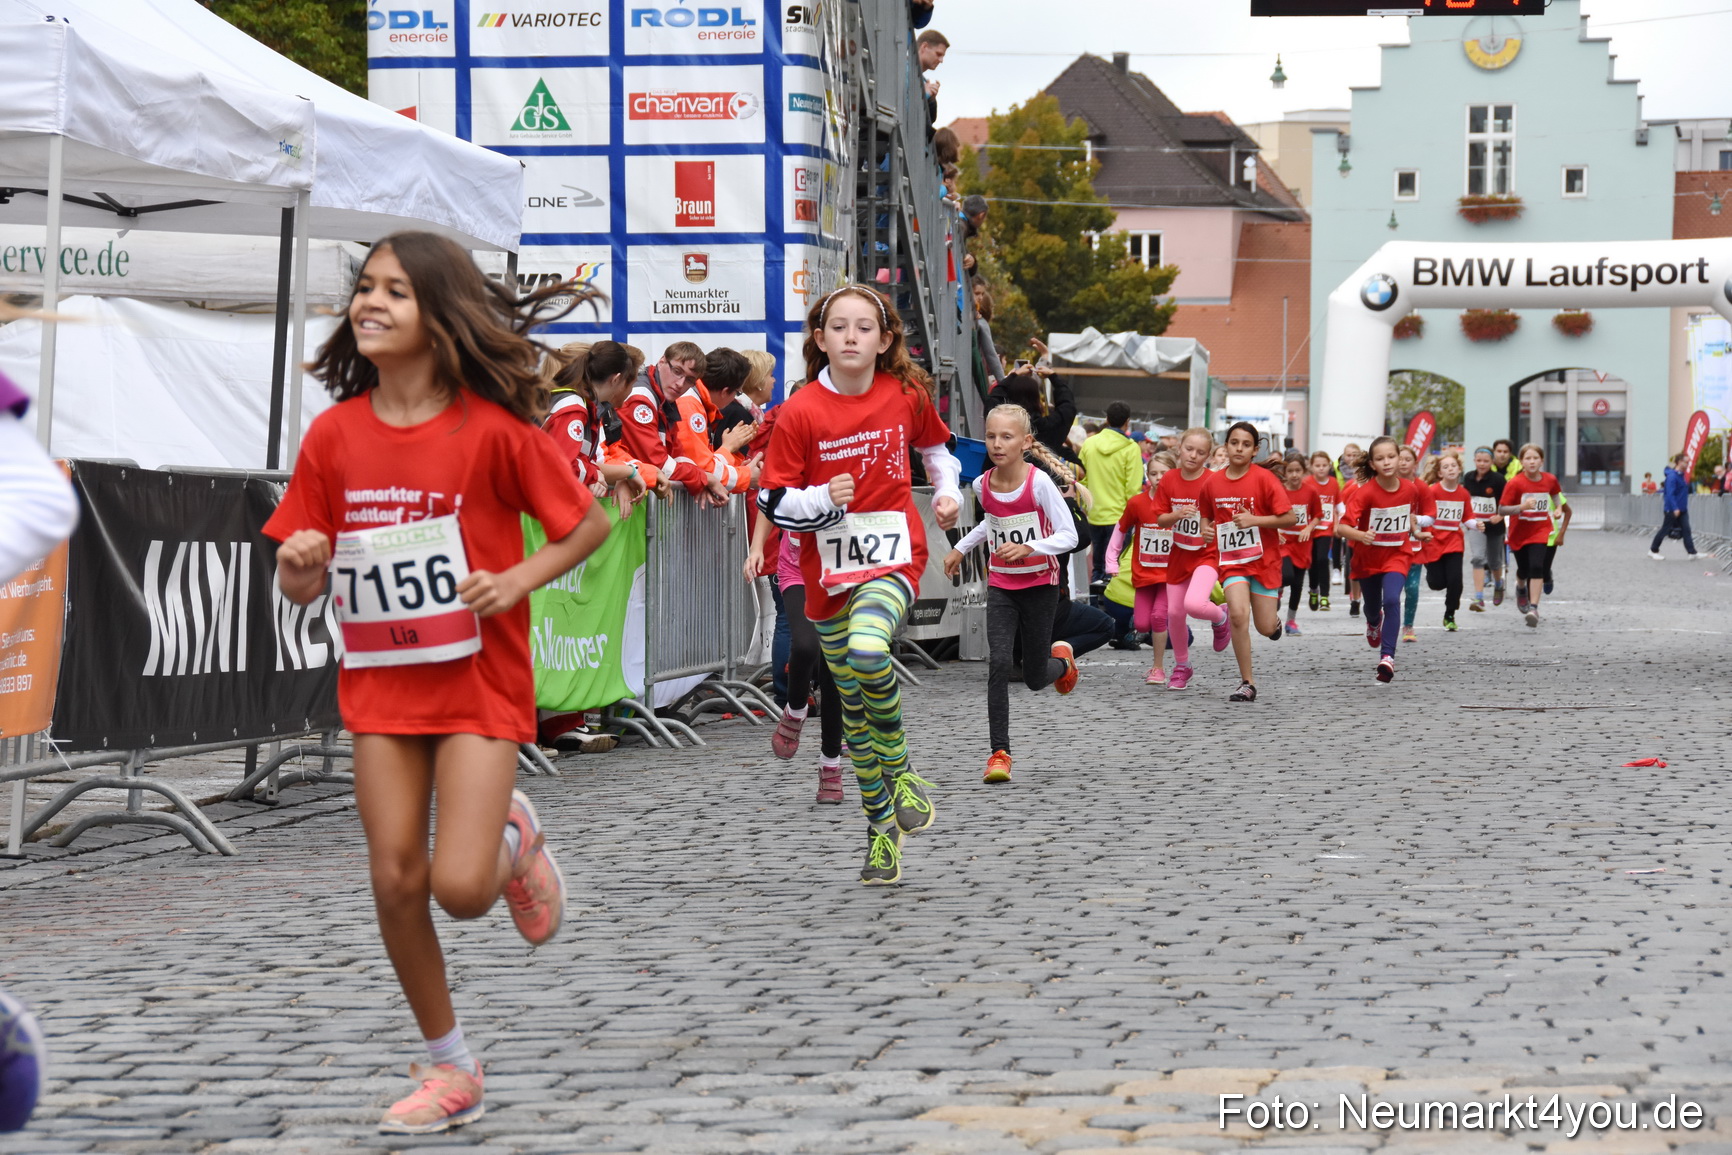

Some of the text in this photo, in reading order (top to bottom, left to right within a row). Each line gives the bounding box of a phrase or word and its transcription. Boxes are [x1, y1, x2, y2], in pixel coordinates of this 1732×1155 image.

[512, 12, 602, 28] VARIOTEC
[389, 25, 448, 43] energie
[698, 24, 756, 41] energie
[634, 91, 724, 113] charivari
[675, 197, 712, 215] Braun
[0, 240, 130, 277] ervce.de
[1413, 256, 1709, 292] BMW Laufsport
[665, 288, 730, 300] Neumarkter
[653, 299, 741, 314] Lammsbräu
[818, 430, 881, 450] Neumarkter
[820, 442, 870, 461] Stadtlauf
[1438, 507, 1462, 519] 7218
[1473, 501, 1494, 513] 7185
[854, 514, 900, 527] BOCK
[1001, 514, 1034, 526] BOCK
[1374, 514, 1408, 532] 7217
[372, 524, 446, 550] BOCK
[1221, 528, 1256, 550] 7421
[826, 533, 901, 569] 7427
[337, 555, 458, 615] 7156
[142, 539, 251, 677] MINI
[390, 626, 420, 646] Lia
[17, 673, 33, 692] 897
